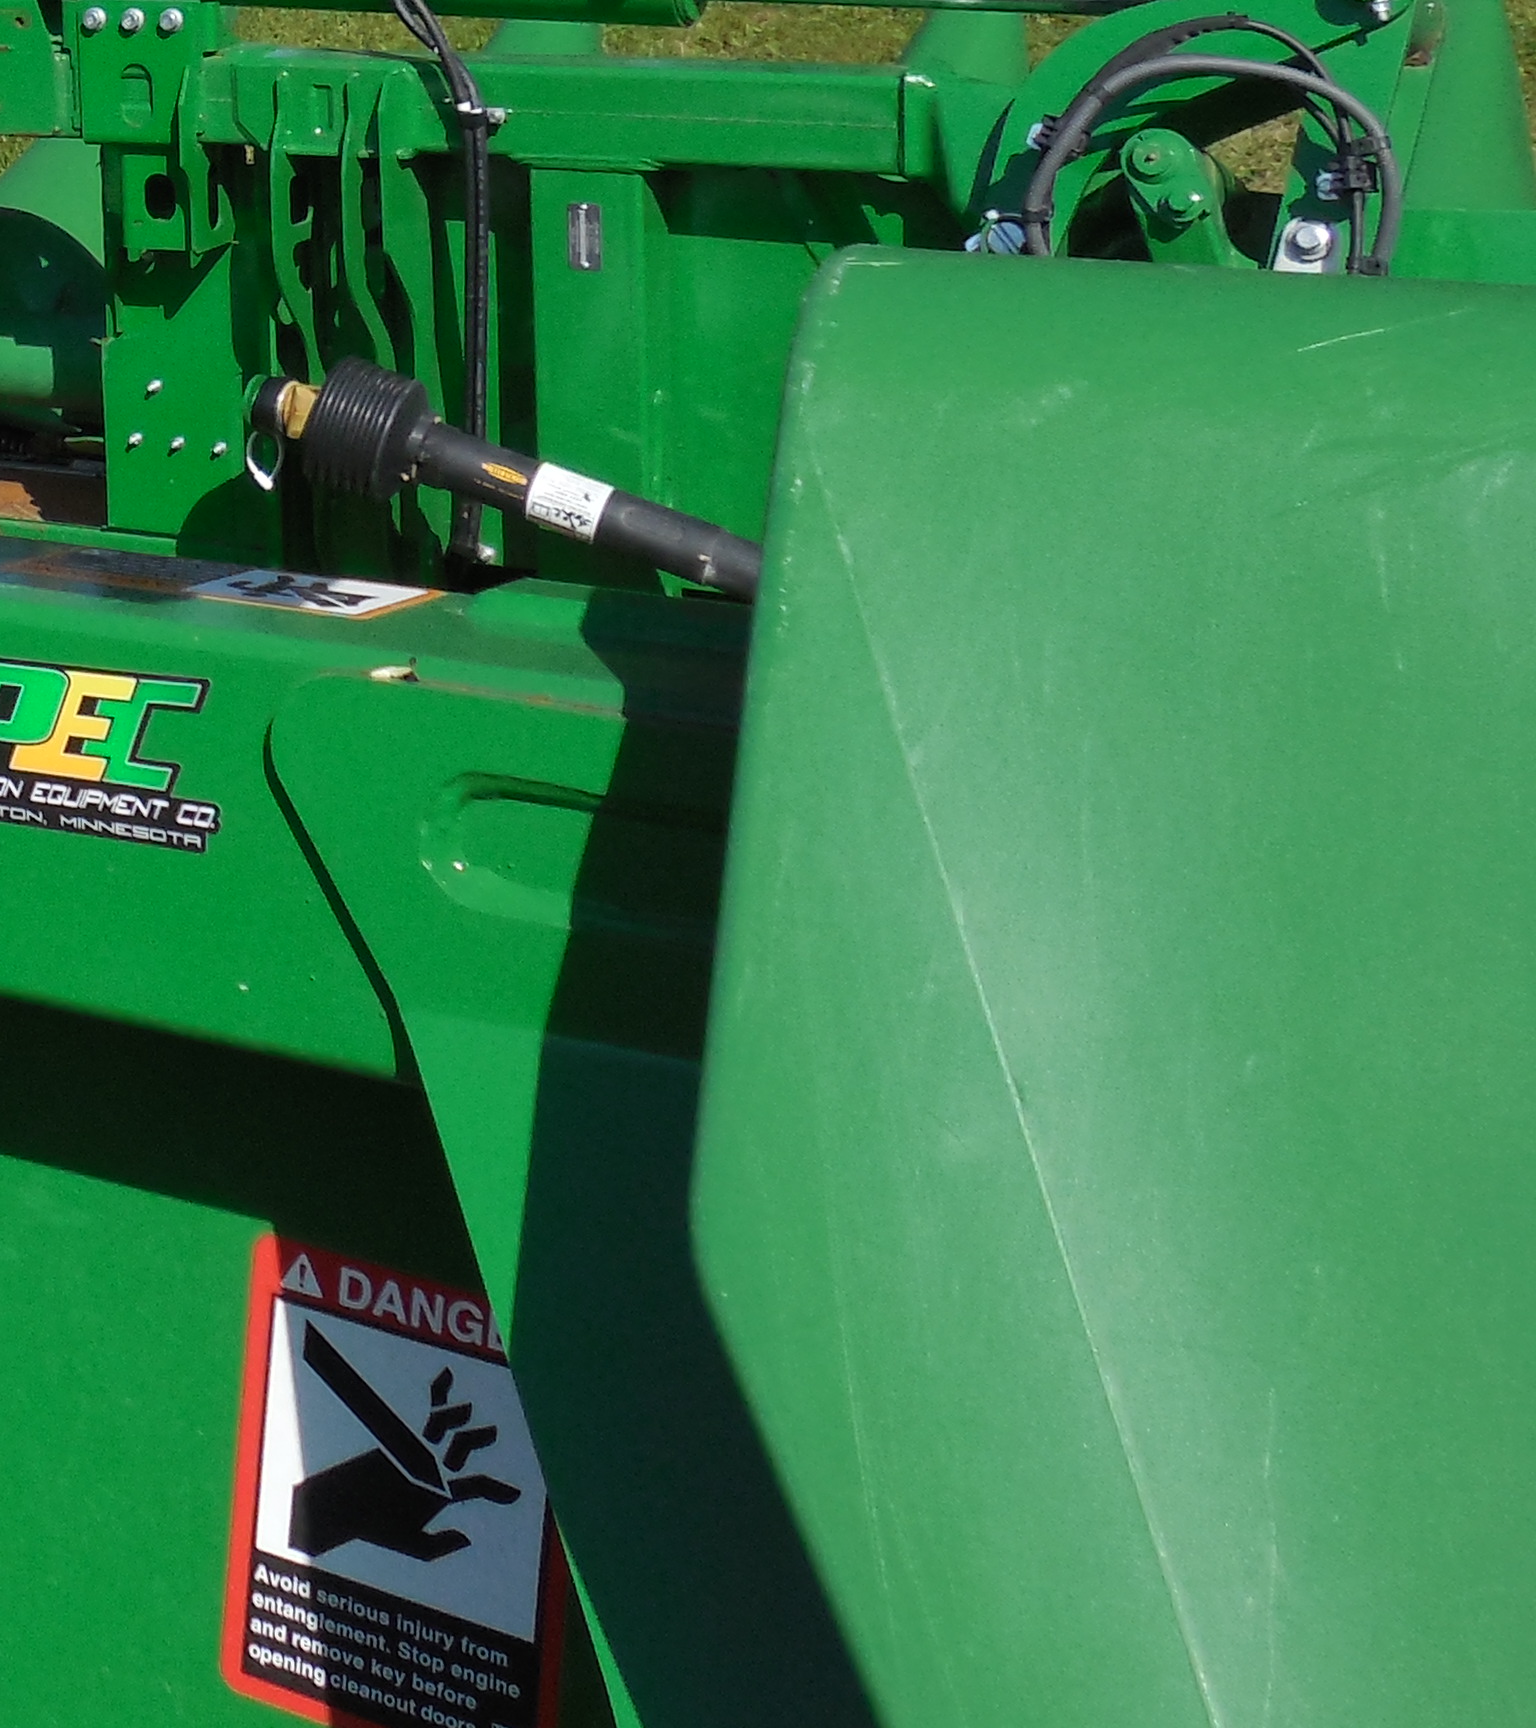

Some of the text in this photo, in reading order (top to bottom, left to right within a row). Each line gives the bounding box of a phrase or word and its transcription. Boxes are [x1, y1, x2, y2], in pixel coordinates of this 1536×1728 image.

[30, 782, 169, 820] EQUIPMENT
[176, 804, 216, 829] CO.
[60, 815, 202, 849] MINNESOTA
[252, 1591, 521, 1699] entanglement. Stop engine
[254, 1564, 509, 1667] Avoid serious injury from
[248, 1643, 327, 1687] opening
[329, 1672, 417, 1715] cleanout
[250, 1617, 477, 1710] and remove key before
